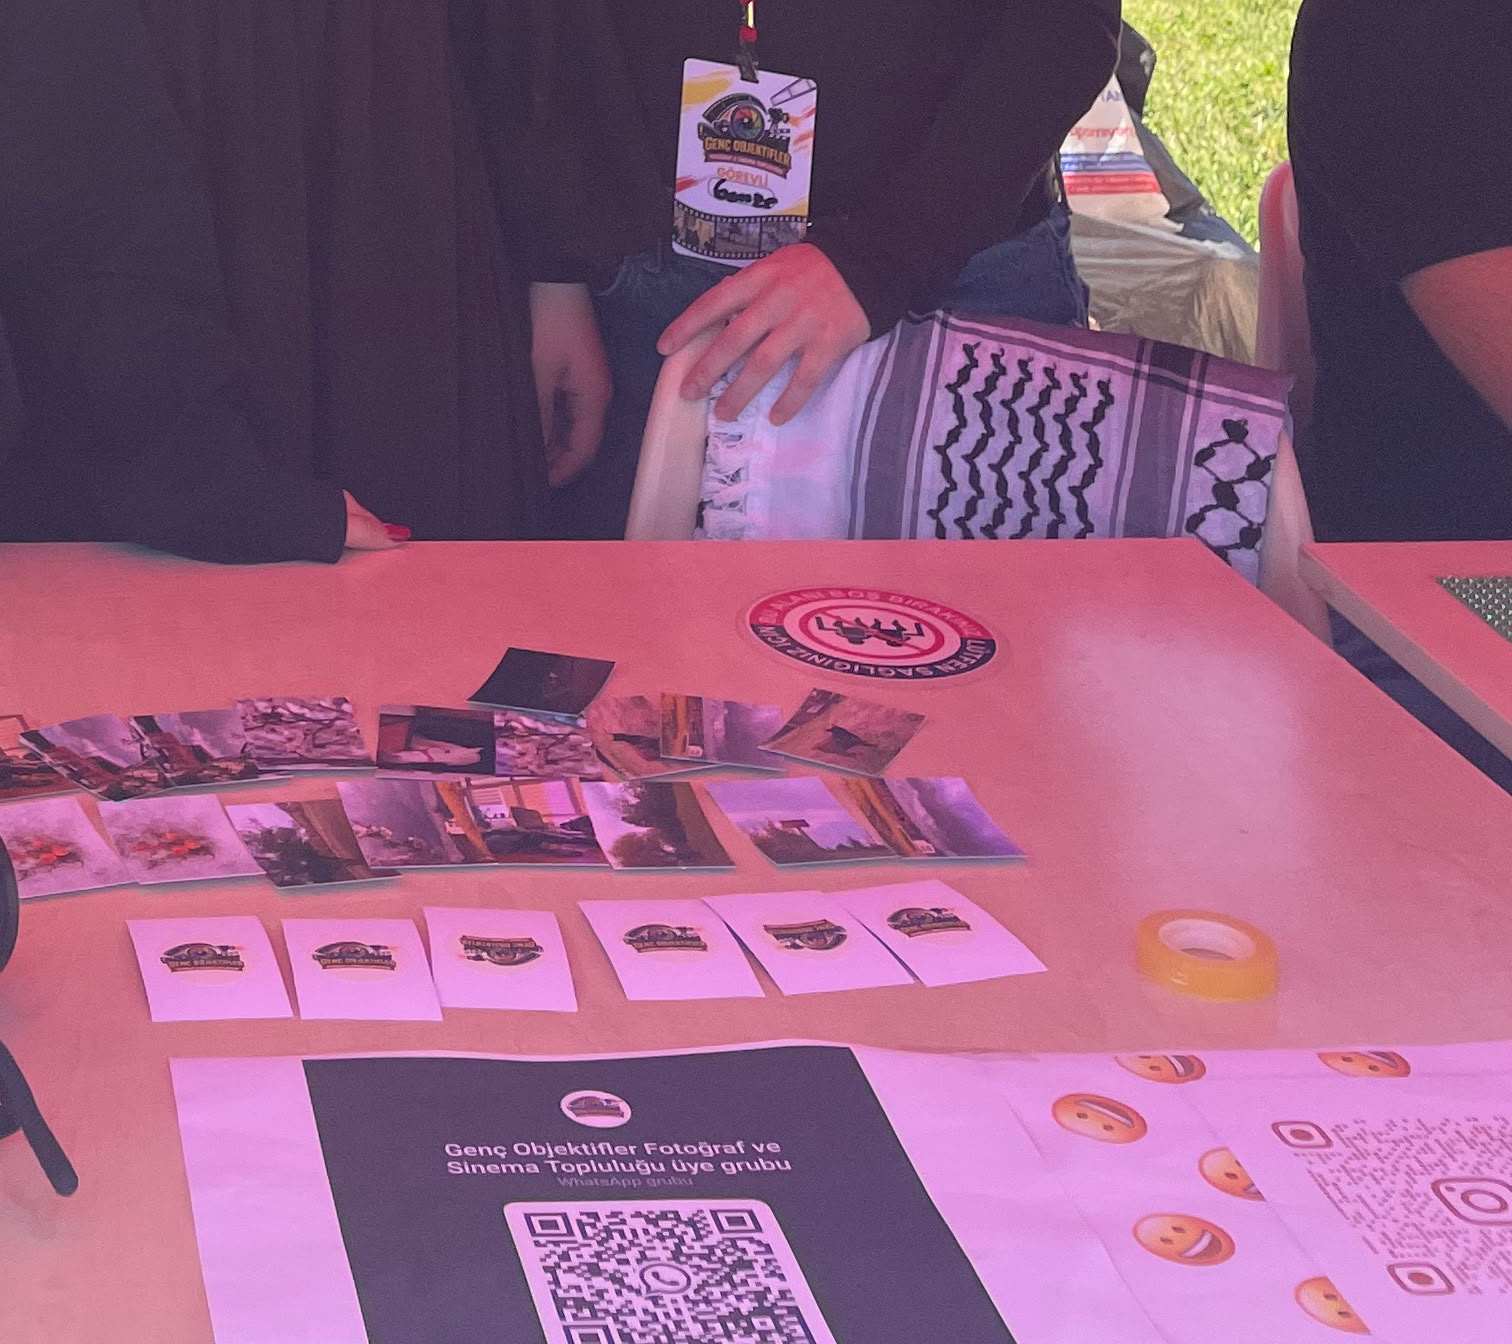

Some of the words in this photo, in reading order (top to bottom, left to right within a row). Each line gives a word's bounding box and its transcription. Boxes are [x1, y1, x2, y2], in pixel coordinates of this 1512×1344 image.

[444, 1142, 508, 1159] Genç
[513, 1141, 638, 1158] Objektifler
[643, 1141, 746, 1157] Fotoğraf
[751, 1141, 781, 1153] ve
[446, 1160, 540, 1174] Sinema
[544, 1159, 666, 1176] Topluluğu
[671, 1158, 716, 1175] üye
[720, 1157, 792, 1175] grubu
[557, 1176, 643, 1189] WhatsApp
[646, 1175, 695, 1188] grubu
